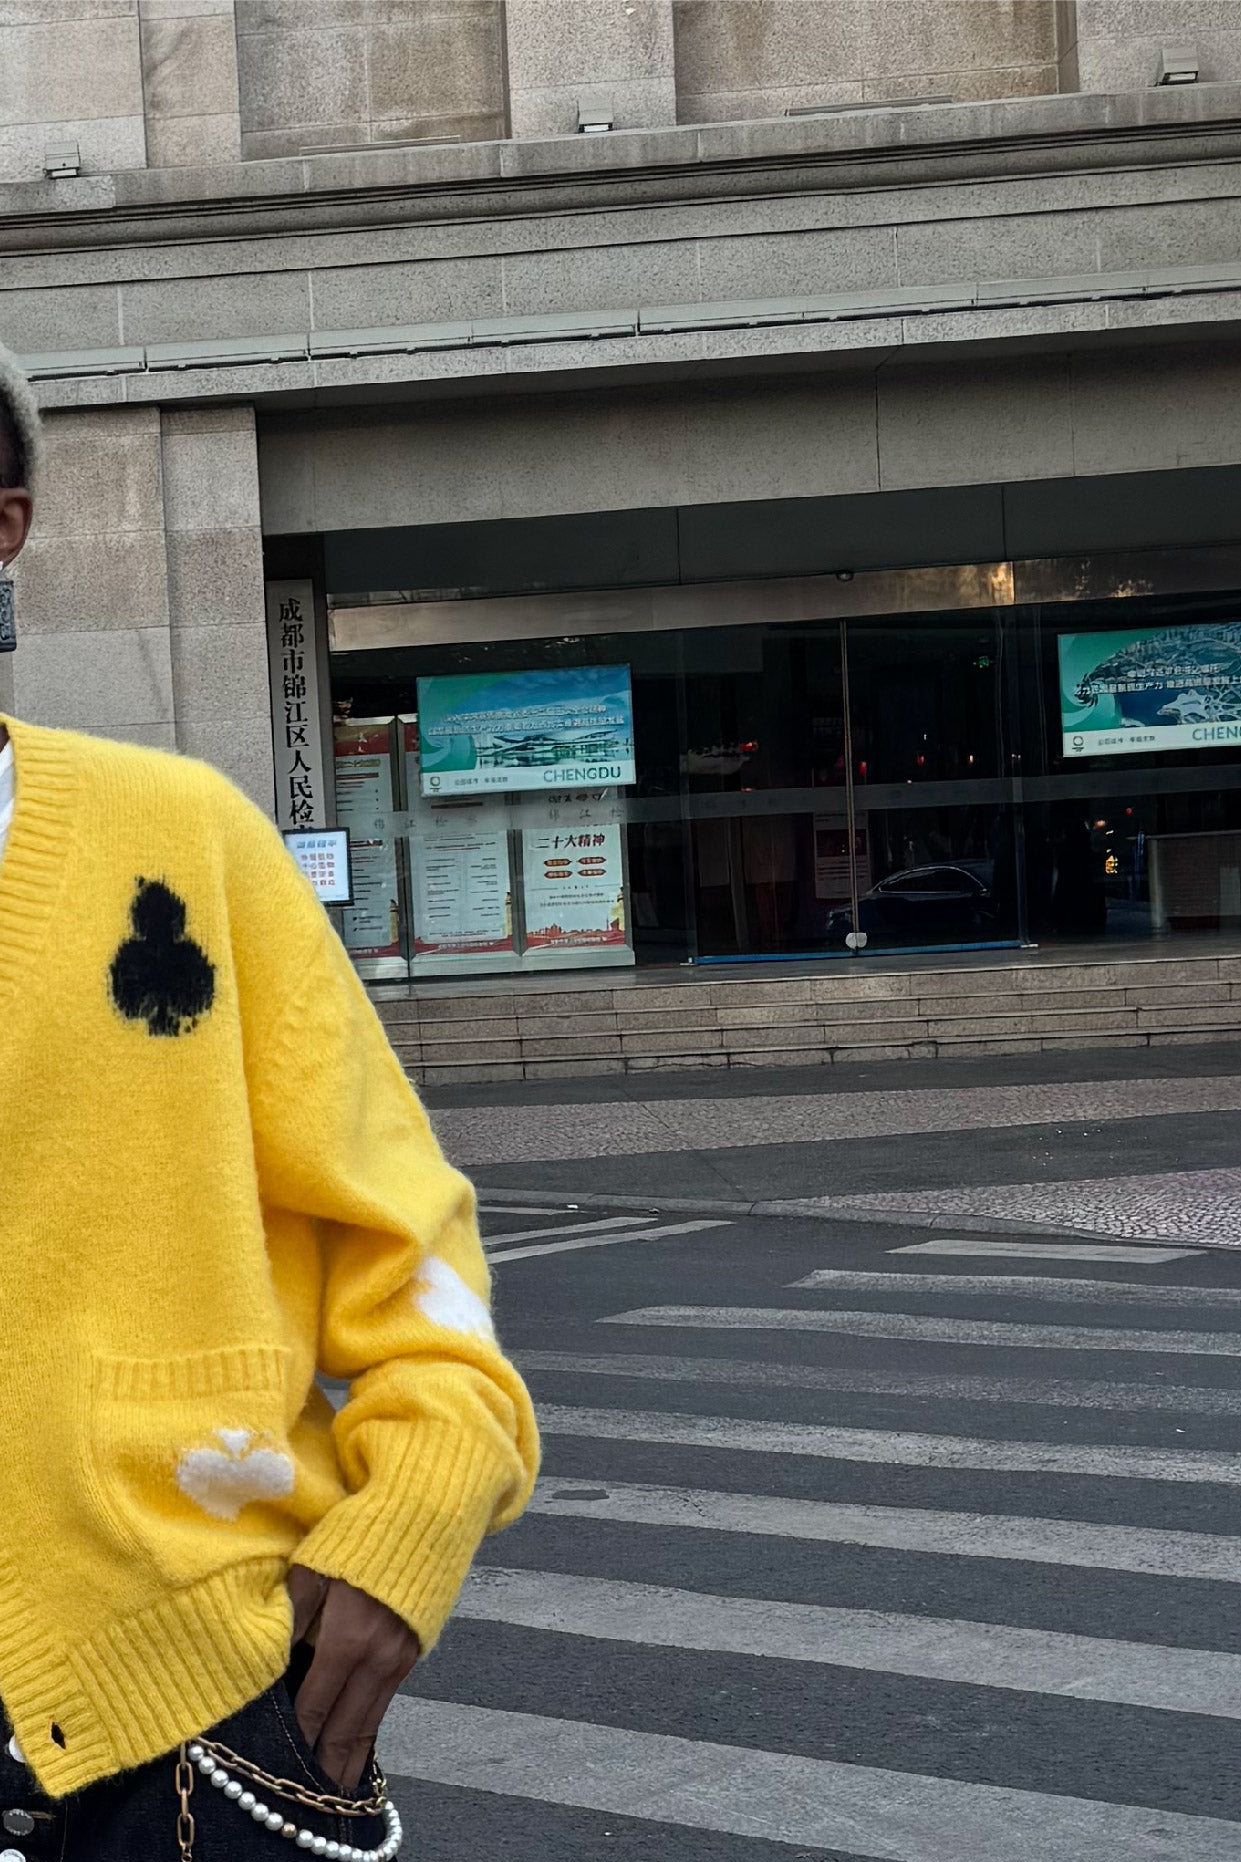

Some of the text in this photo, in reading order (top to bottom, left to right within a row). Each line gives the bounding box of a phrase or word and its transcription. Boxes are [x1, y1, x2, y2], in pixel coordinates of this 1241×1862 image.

[278, 597, 316, 829] 成都市锦江区人民检
[1192, 725, 1241, 741] CHEN
[543, 766, 622, 783] CHENGDU
[536, 832, 606, 850] 二十大精神
